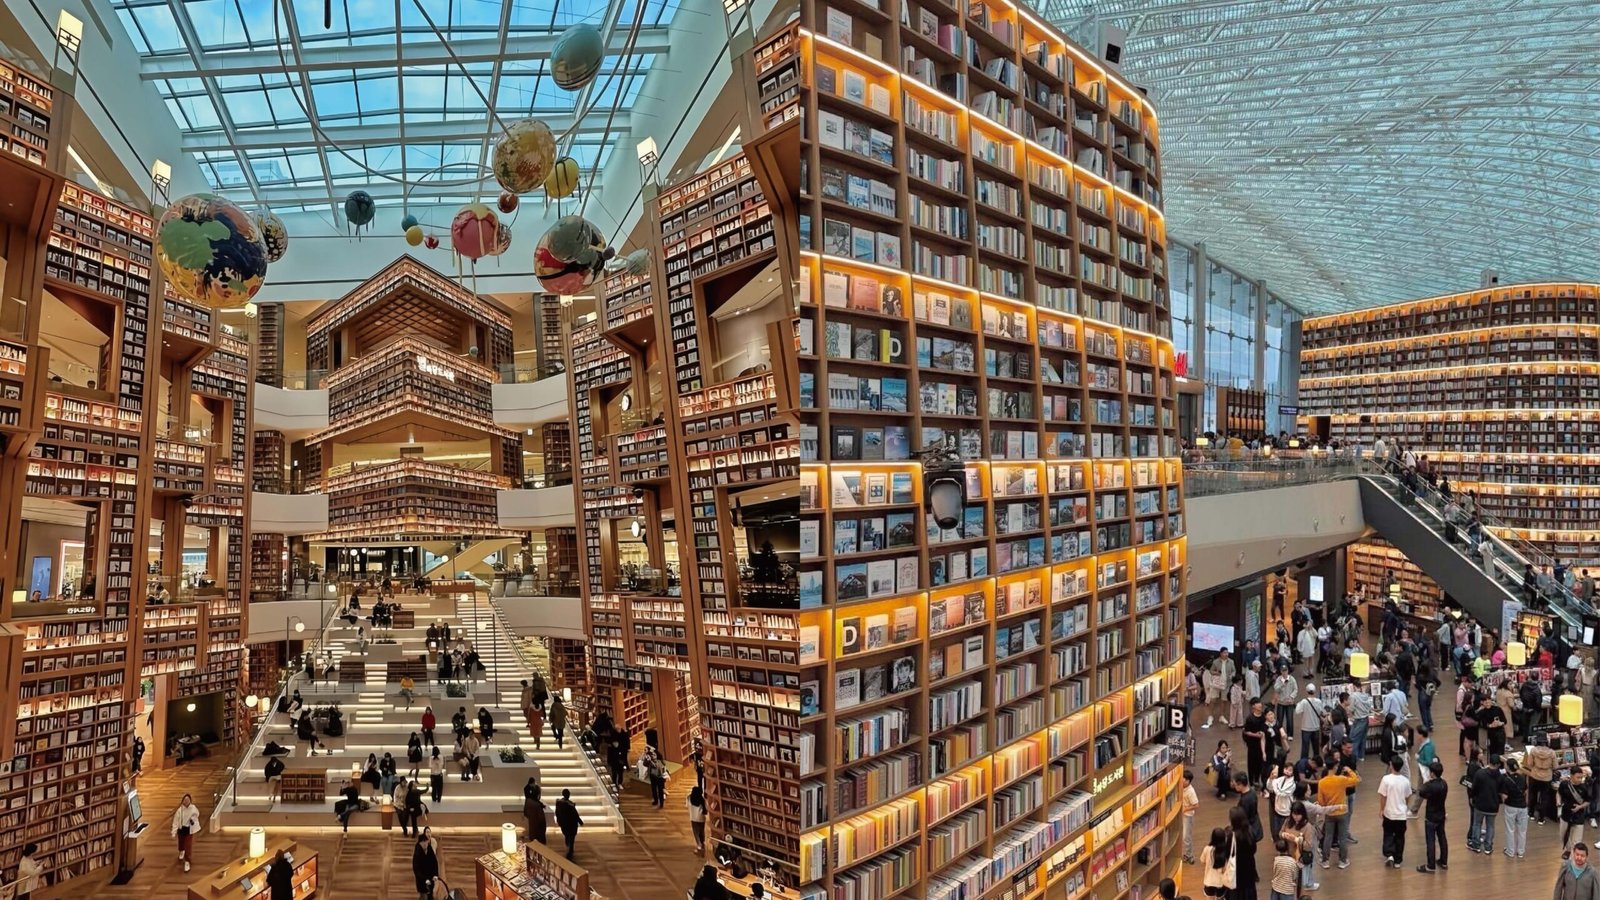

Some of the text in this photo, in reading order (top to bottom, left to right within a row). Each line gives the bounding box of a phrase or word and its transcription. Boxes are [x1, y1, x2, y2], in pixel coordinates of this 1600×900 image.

[890, 338, 901, 356] D
[843, 626, 857, 646] D
[1171, 708, 1184, 729] B
